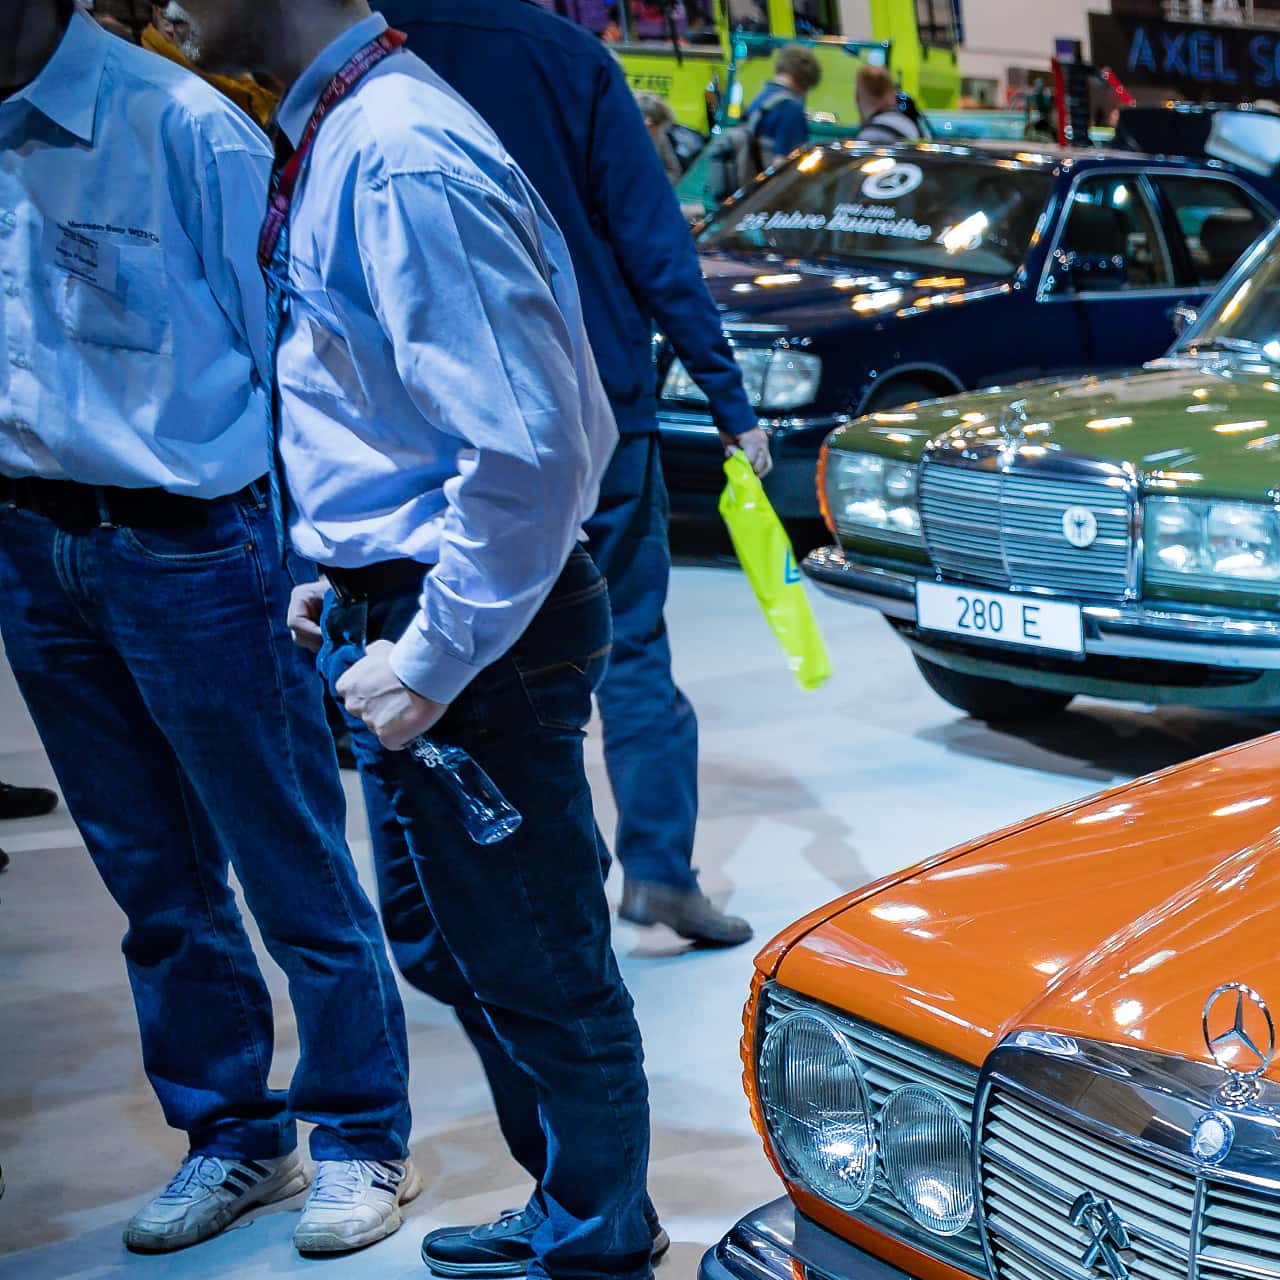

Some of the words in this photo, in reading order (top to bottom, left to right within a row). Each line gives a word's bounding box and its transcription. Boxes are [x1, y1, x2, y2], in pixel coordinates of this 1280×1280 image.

[1127, 26, 1238, 84] AXEL
[763, 210, 826, 230] Jahre
[825, 214, 933, 241] Baureihe
[957, 596, 1003, 632] 280
[1022, 603, 1042, 640] E
